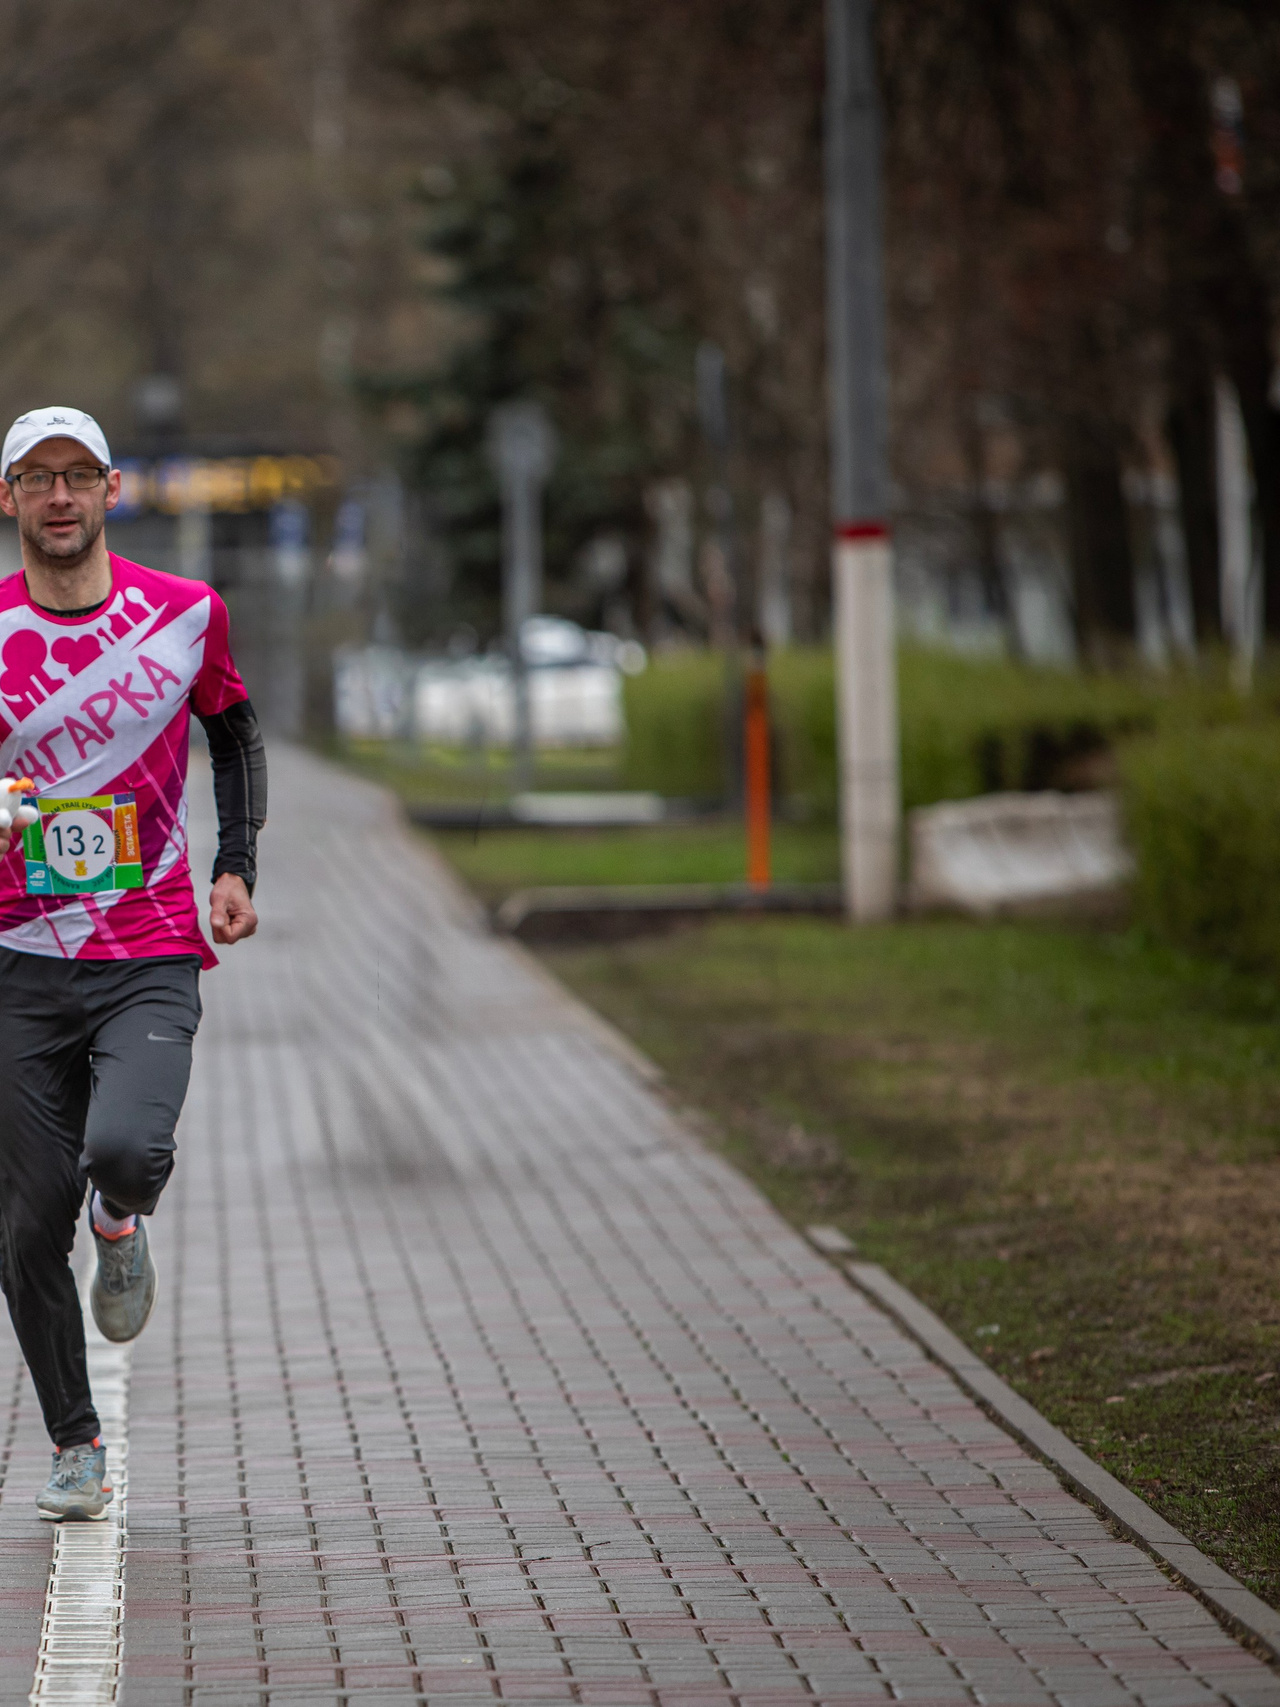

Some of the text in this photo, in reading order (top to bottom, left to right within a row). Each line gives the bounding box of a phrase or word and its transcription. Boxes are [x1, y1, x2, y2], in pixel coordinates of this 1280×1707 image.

[4, 655, 182, 787] НГАРКА
[61, 801, 80, 809] TRAIL
[52, 824, 86, 856] 13
[92, 834, 106, 855] 2
[124, 813, 136, 857] ЭСТАФЕТА
